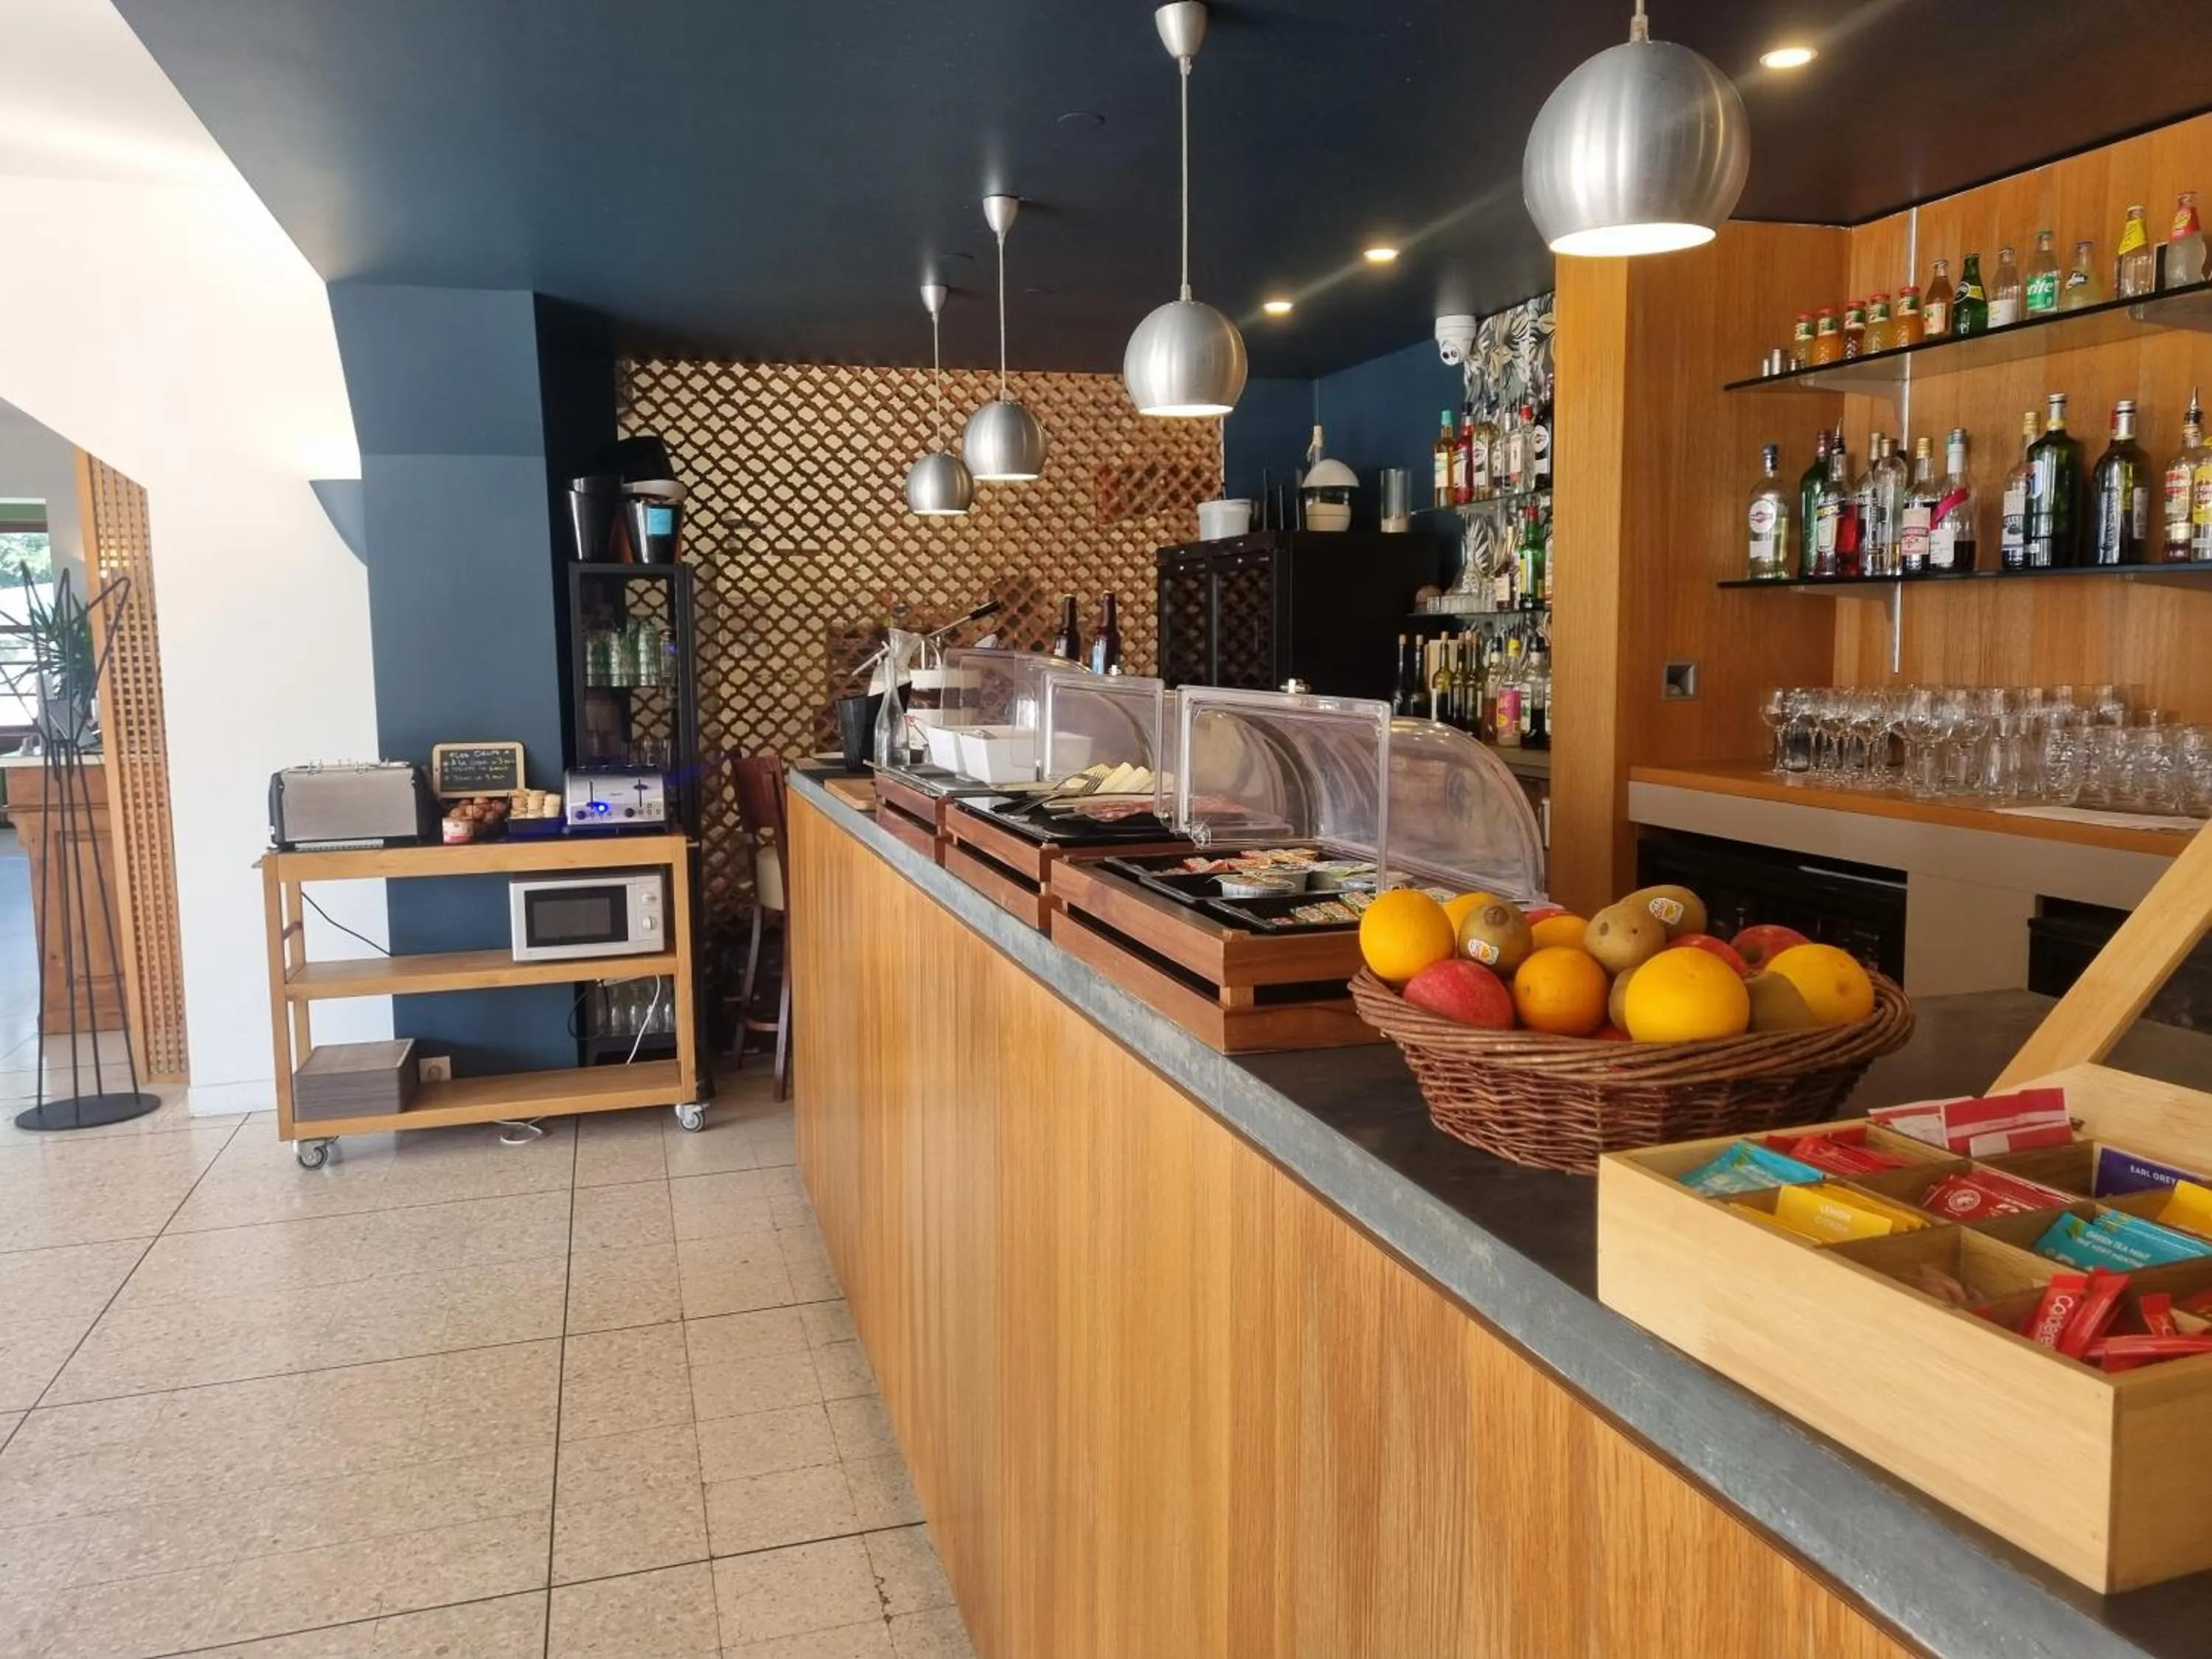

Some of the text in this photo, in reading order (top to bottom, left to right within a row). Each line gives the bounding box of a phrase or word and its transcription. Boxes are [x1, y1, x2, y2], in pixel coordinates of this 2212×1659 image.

[2130, 1165, 2177, 1186] EARL GREY
[2085, 1231, 2152, 1262] GREEN TEA MINT
